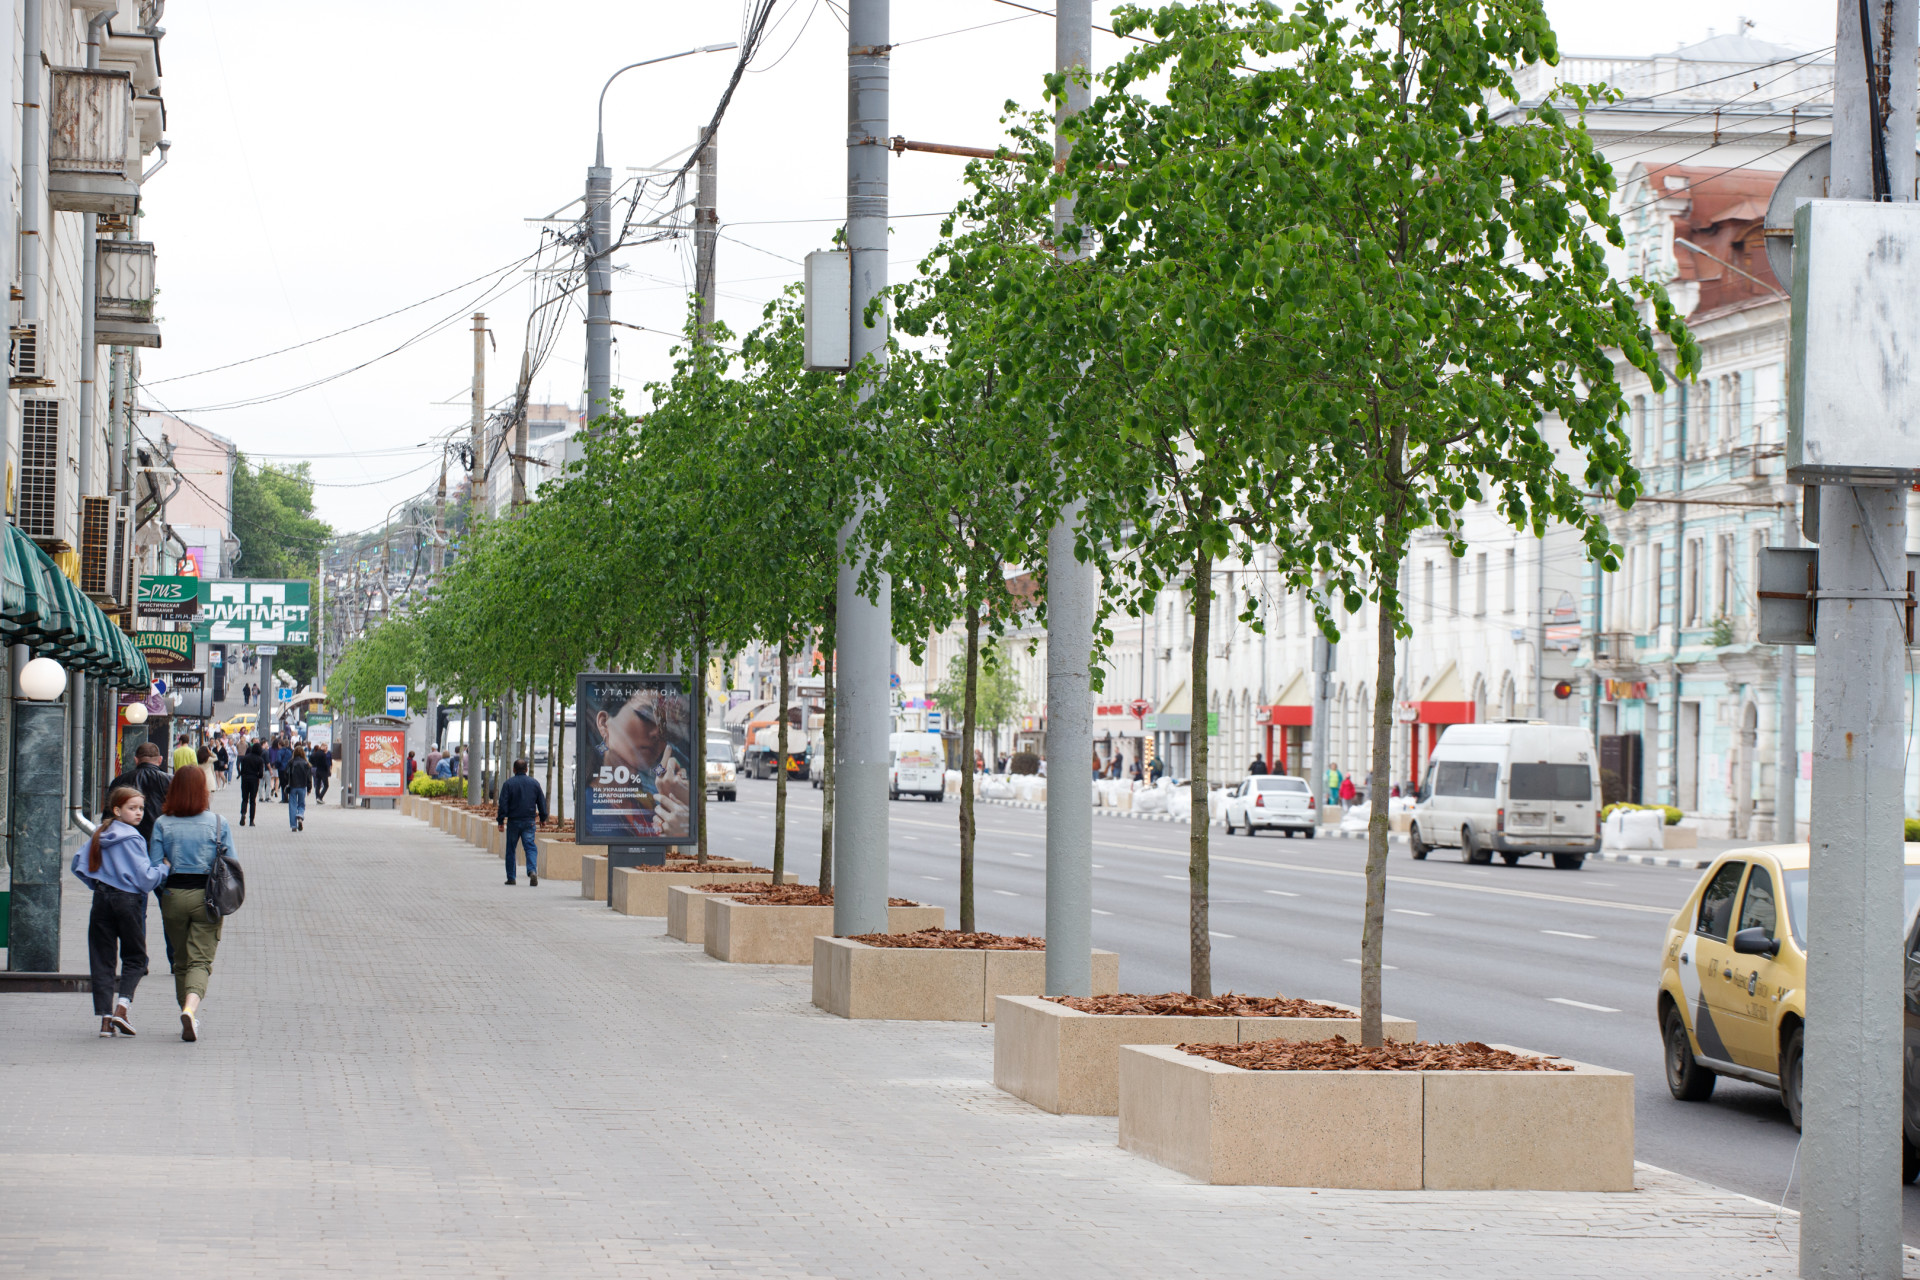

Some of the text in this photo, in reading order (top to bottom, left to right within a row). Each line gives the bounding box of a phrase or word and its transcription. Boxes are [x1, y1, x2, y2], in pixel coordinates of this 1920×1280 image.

[202, 603, 310, 622] ОЛИПЛАСТ
[131, 633, 188, 653] ЛАТОНОВ
[287, 631, 309, 642] ЛЕТ
[594, 688, 677, 696] ТУТАНХАМОН
